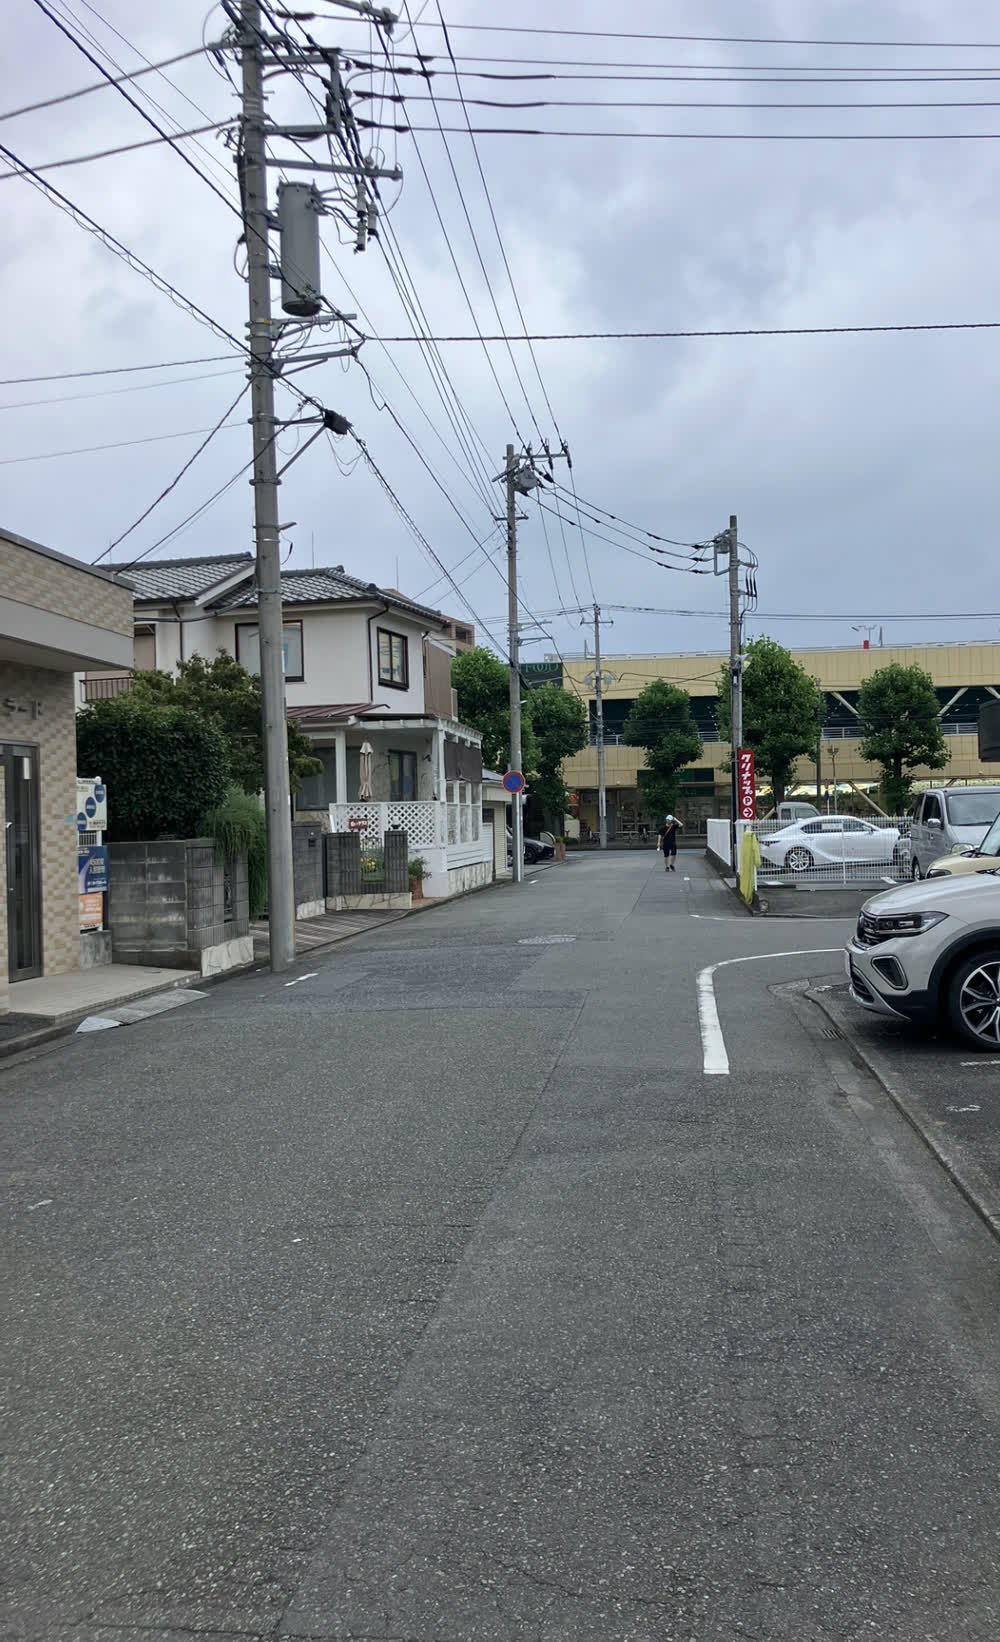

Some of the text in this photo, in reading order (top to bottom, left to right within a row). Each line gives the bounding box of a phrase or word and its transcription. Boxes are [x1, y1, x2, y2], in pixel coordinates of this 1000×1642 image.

[741, 754, 754, 794] クリナップ
